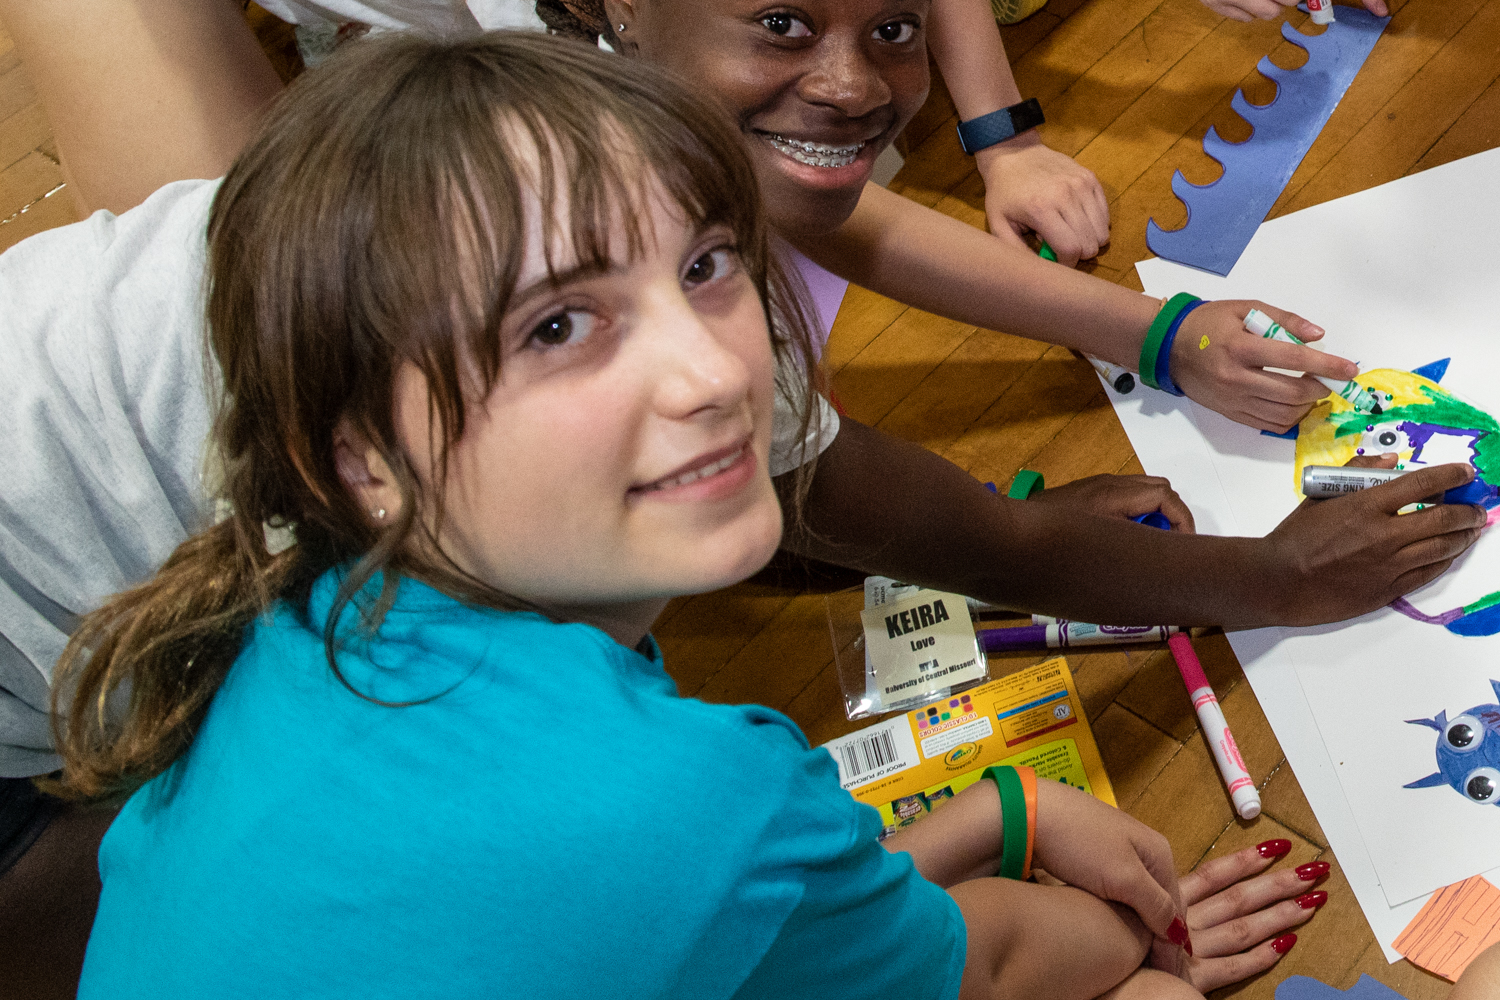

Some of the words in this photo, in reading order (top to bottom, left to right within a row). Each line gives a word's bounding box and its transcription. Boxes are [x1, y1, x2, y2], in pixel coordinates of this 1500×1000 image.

[1342, 483, 1364, 492] KING
[884, 599, 950, 639] KEIRA
[910, 636, 936, 652] Love
[885, 678, 918, 694] University
[925, 668, 949, 682] Central
[949, 658, 976, 674] Missouri
[1056, 706, 1067, 717] AP
[942, 715, 968, 729] CLASSIC
[919, 725, 942, 738] COLORS
[1039, 747, 1061, 758] Colored
[886, 762, 907, 773] PROOF
[843, 773, 875, 789] PURCHASE
